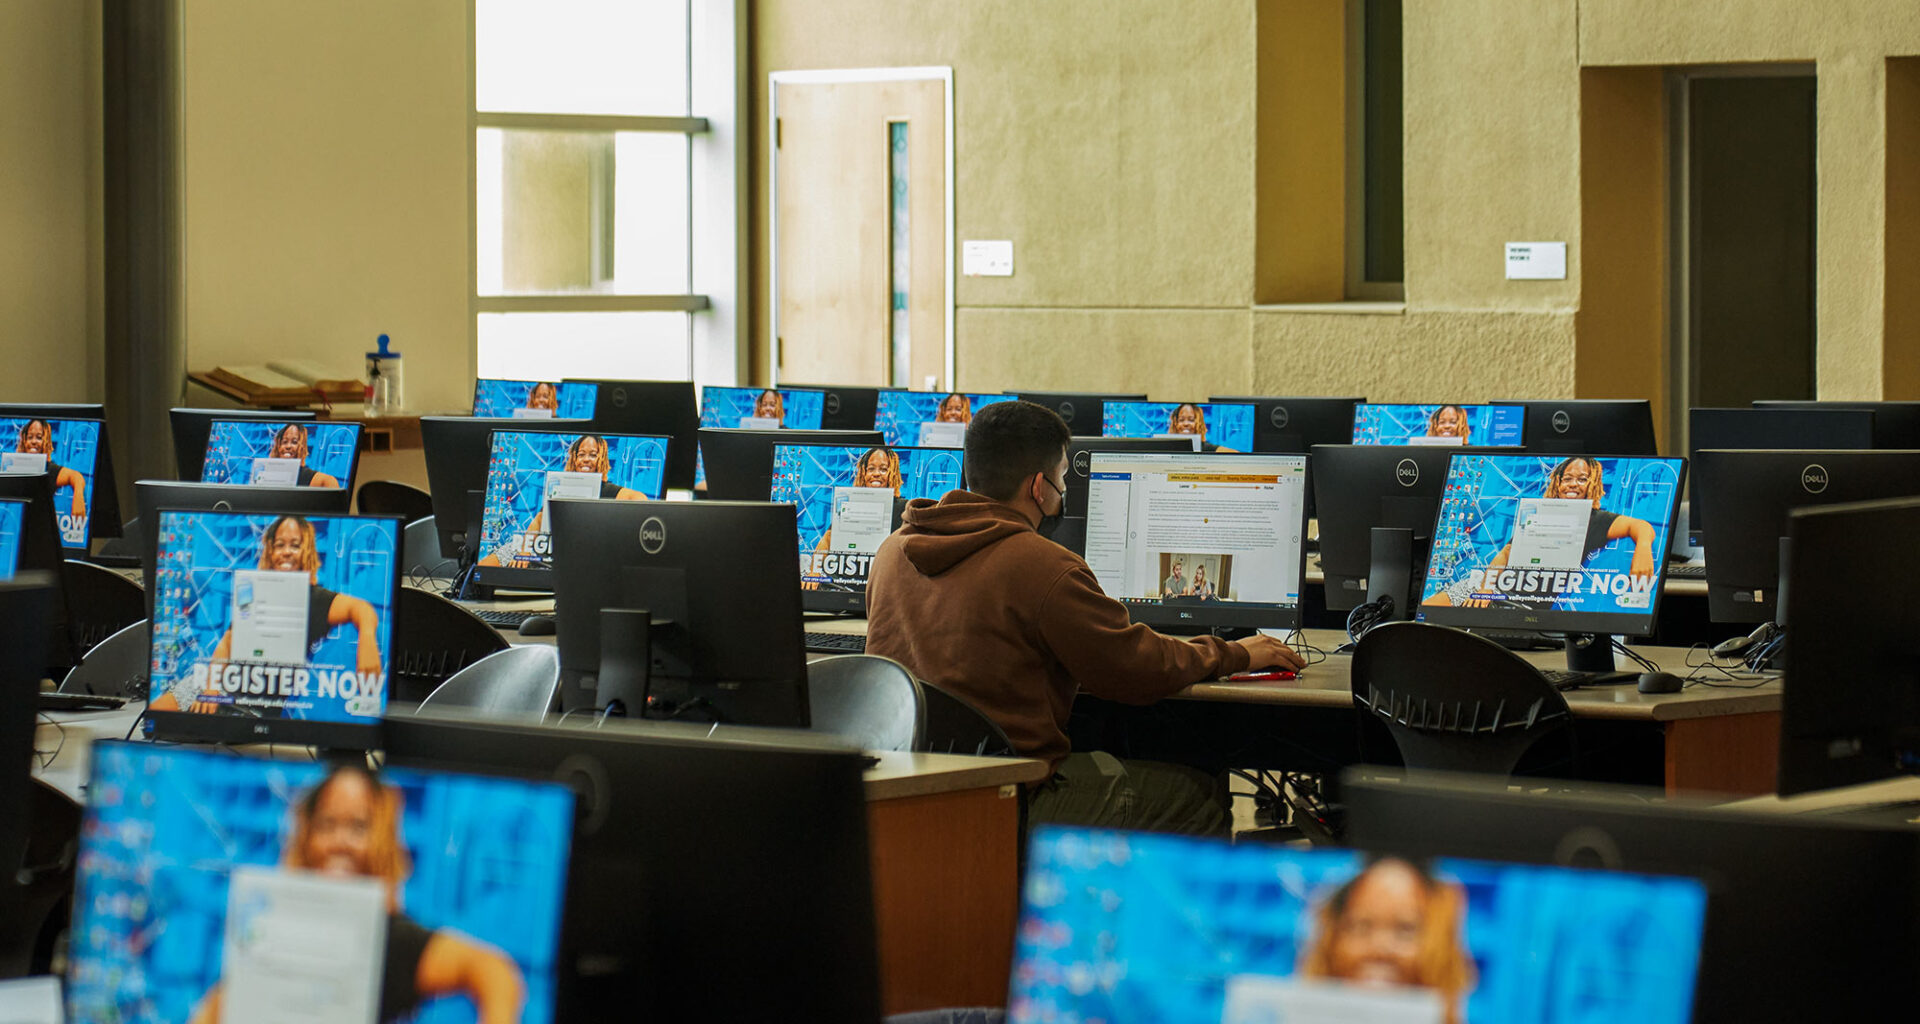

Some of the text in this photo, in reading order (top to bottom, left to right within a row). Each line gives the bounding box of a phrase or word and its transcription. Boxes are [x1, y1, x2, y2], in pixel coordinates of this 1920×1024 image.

[1399, 468, 1417, 477] DELL
[1804, 474, 1826, 484] DELL
[56, 514, 89, 532] OW
[642, 530, 664, 541] DELL
[1468, 569, 1658, 596] REGISTER NOW
[193, 664, 385, 699] REGISTER NOW
